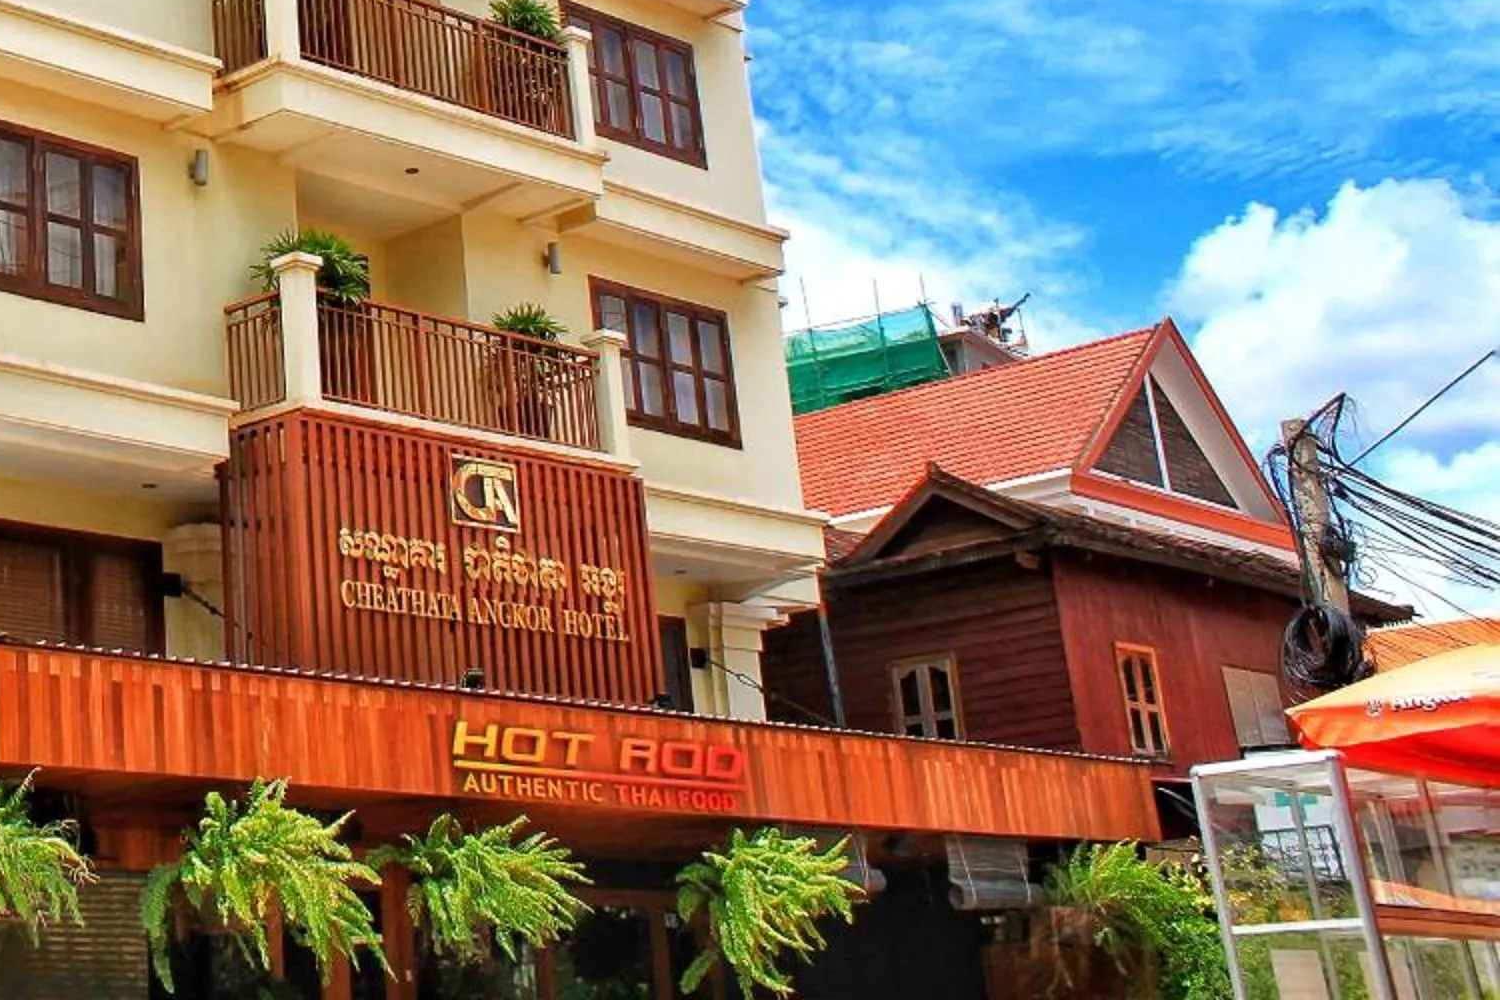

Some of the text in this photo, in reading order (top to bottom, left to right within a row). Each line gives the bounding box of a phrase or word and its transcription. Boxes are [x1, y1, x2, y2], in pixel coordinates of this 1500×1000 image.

[340, 579, 629, 641] CHEATHATA ANGKOR HOTEL
[452, 720, 745, 779] HOT ROD
[463, 772, 739, 812] AUTHENTIC THAI FOOD
